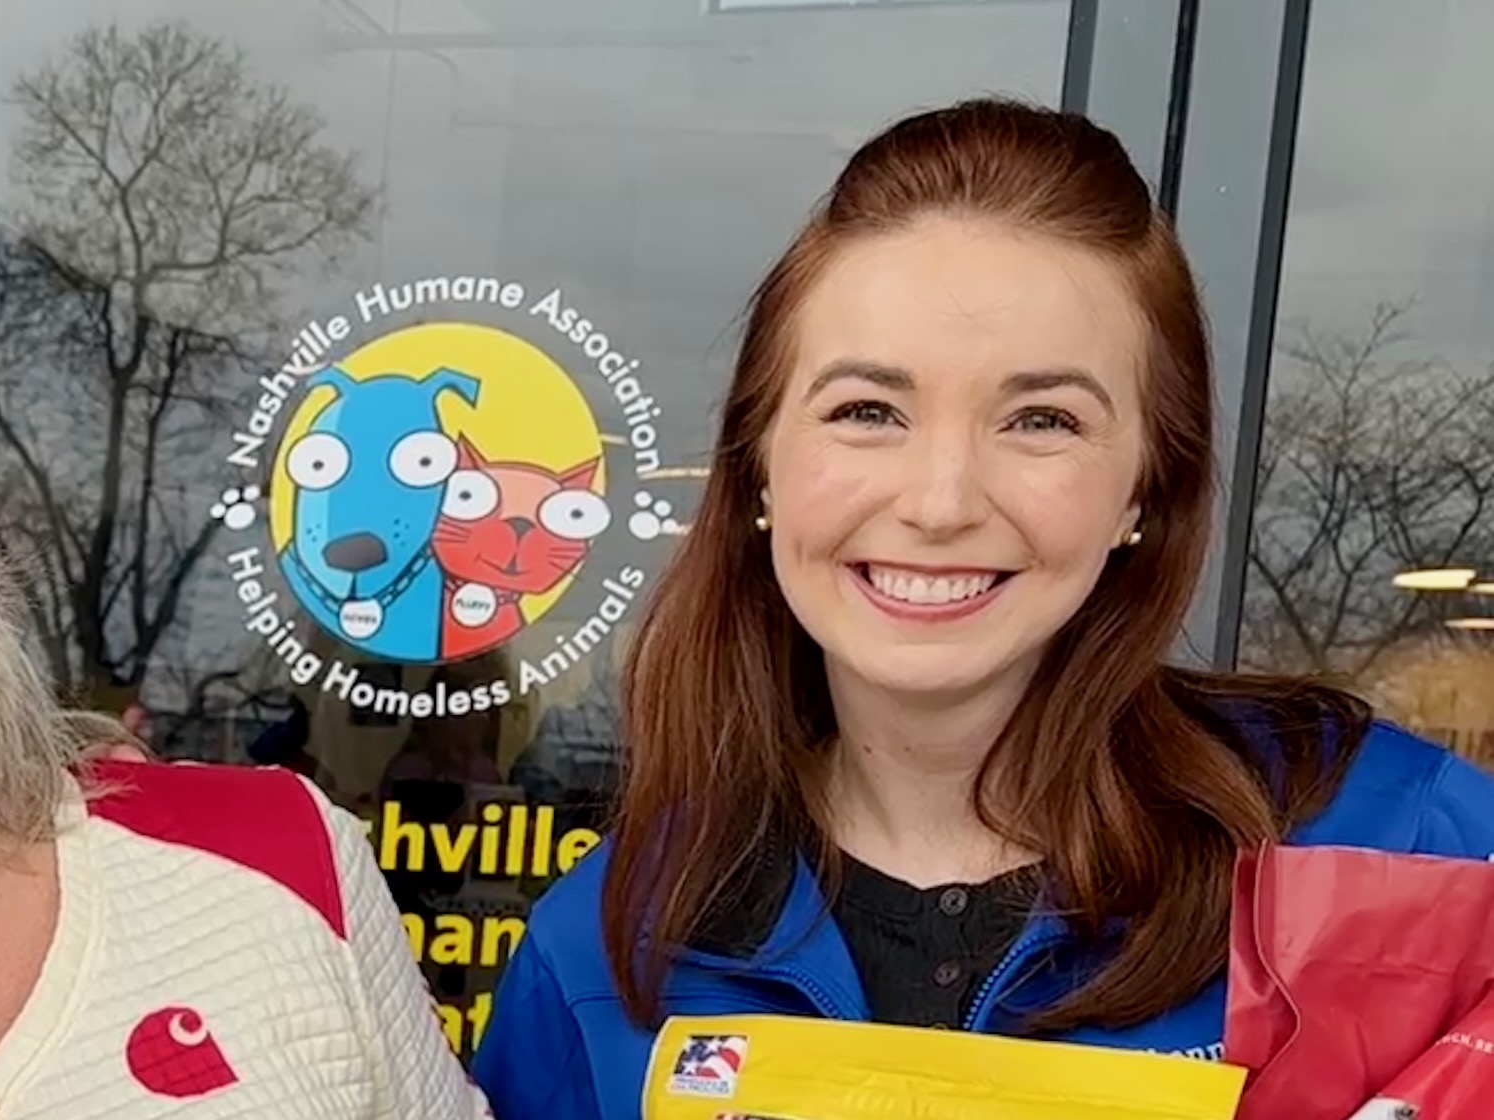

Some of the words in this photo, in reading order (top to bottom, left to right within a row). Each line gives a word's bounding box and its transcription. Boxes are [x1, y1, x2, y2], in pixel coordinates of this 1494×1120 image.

[228, 314, 351, 468] Nashville
[355, 275, 525, 323] Humane
[530, 288, 663, 475] Association
[228, 547, 322, 685] Helping
[322, 660, 511, 719] Homeless
[519, 563, 646, 696] Animals
